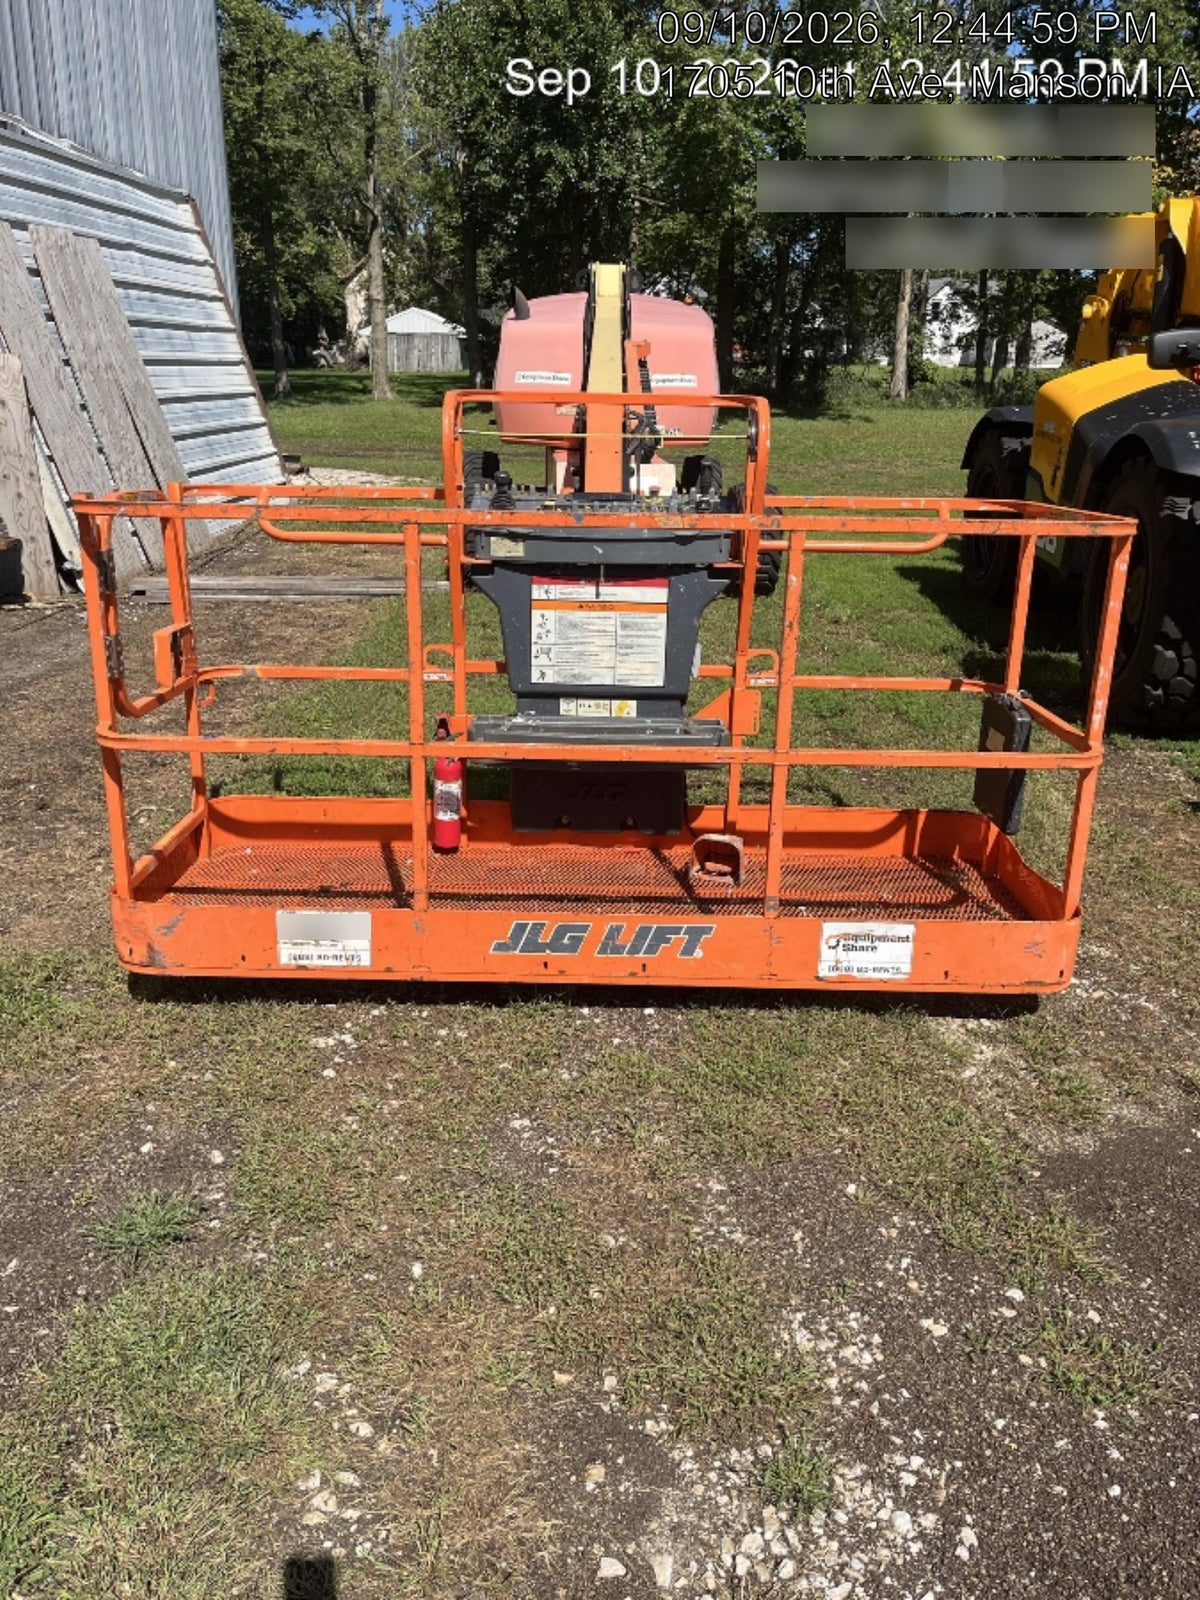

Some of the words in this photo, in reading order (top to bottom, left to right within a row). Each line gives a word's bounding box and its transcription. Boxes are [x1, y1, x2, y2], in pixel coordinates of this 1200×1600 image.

[490, 920, 593, 956] JLG
[594, 922, 717, 958] LIFT
[842, 943, 878, 953] Share
